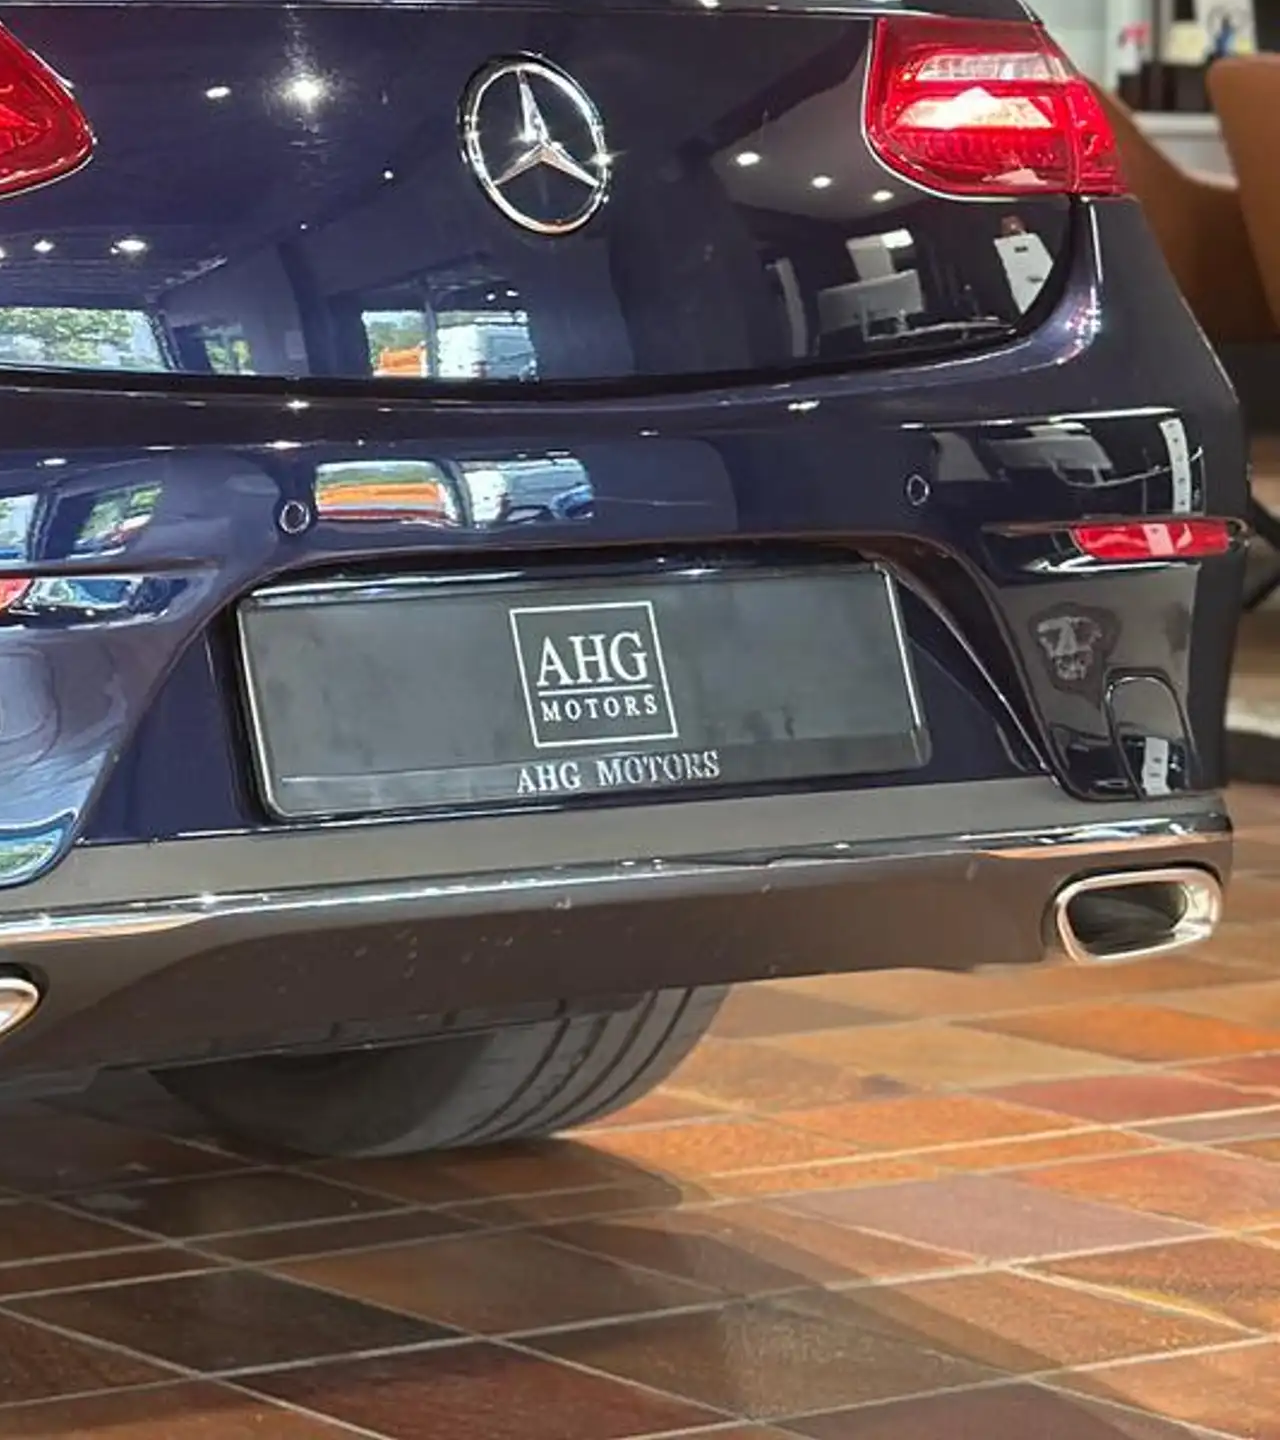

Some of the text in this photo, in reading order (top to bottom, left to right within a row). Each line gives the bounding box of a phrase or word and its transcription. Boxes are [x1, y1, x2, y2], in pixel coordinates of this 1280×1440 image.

[536, 630, 649, 687] AHG
[541, 693, 658, 722] MOTORS
[516, 749, 721, 795] AHG MOTORS
